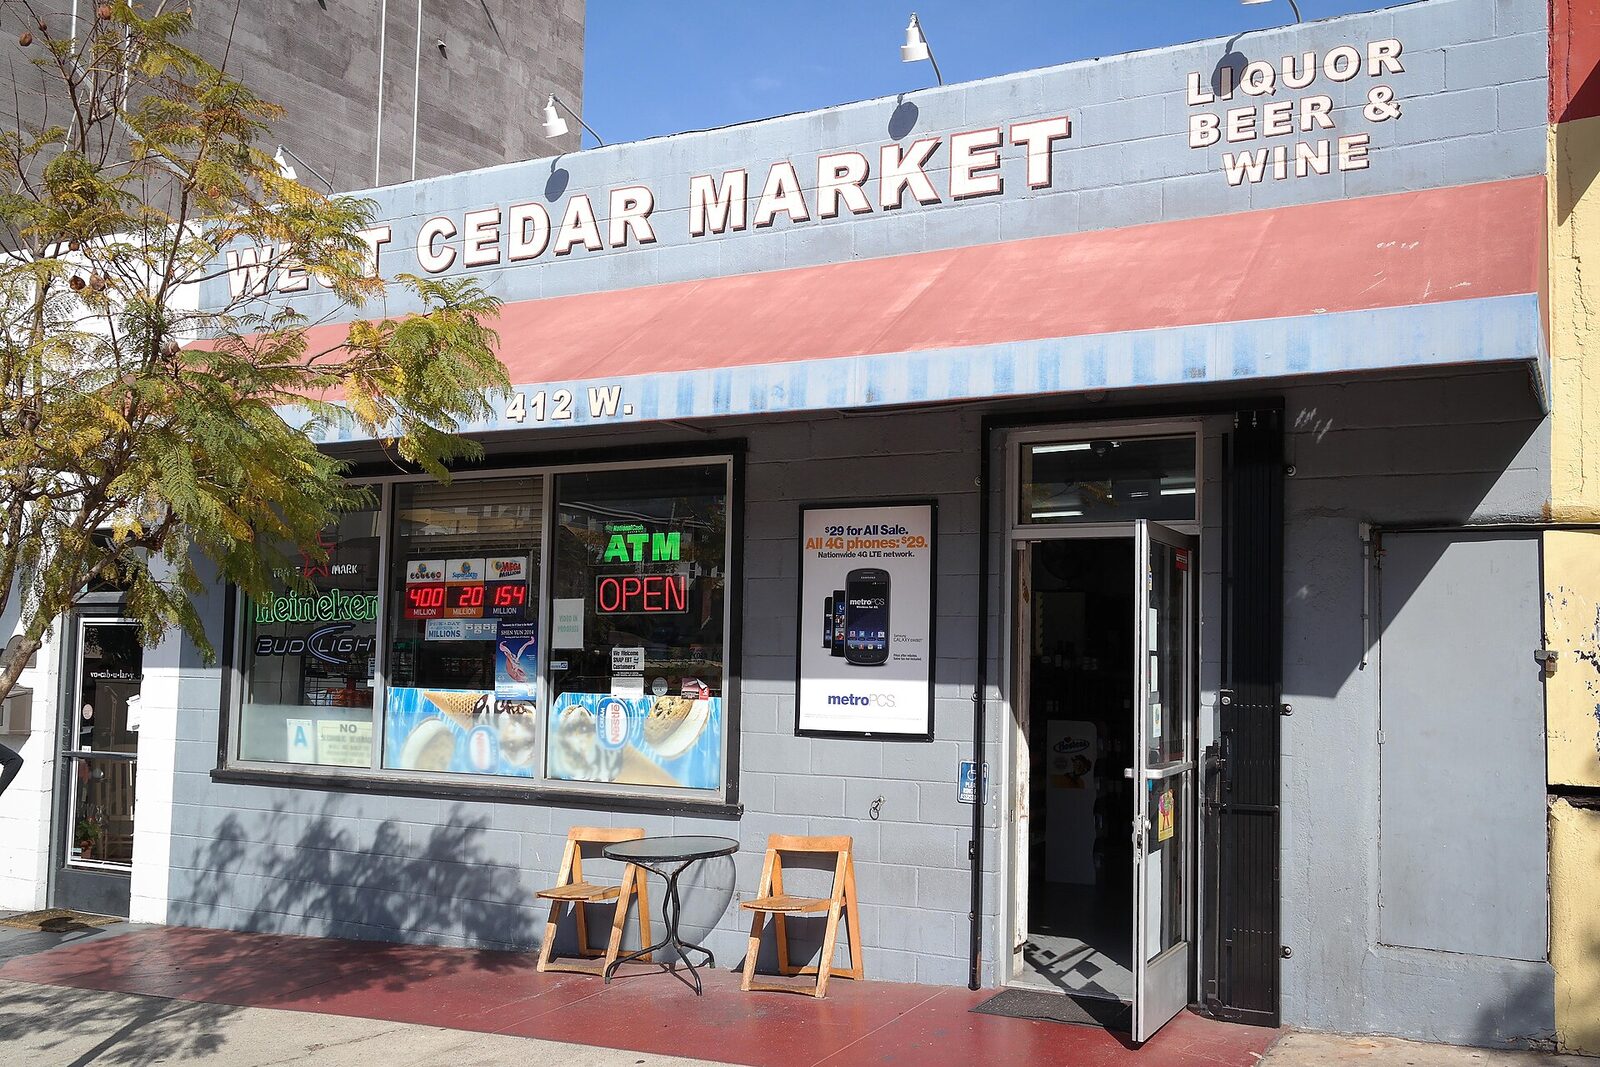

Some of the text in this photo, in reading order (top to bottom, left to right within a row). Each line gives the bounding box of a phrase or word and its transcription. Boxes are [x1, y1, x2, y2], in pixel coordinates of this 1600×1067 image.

[1187, 38, 1405, 106] LIQUOR
[1188, 85, 1402, 148] BEER &
[1222, 133, 1370, 187] WINE
[417, 185, 656, 273] CEDAR
[689, 115, 1071, 238] MARKET
[505, 385, 634, 423] 412 W.
[825, 524, 909, 536] $29 for All Sale.
[602, 532, 681, 563] ATM
[806, 536, 928, 551] All 4G phones: $29.
[331, 563, 358, 575] MARK
[410, 588, 444, 607] 400
[459, 587, 483, 606] 20
[494, 586, 525, 606] 154
[599, 576, 686, 611] OPEN
[413, 608, 437, 616] MILLION
[452, 607, 476, 615] MILLION
[492, 607, 517, 615] MILLION
[428, 630, 461, 638] MILLIONS
[256, 638, 377, 653] BUD LIGH
[294, 725, 308, 747] A
[339, 724, 357, 733] NO
